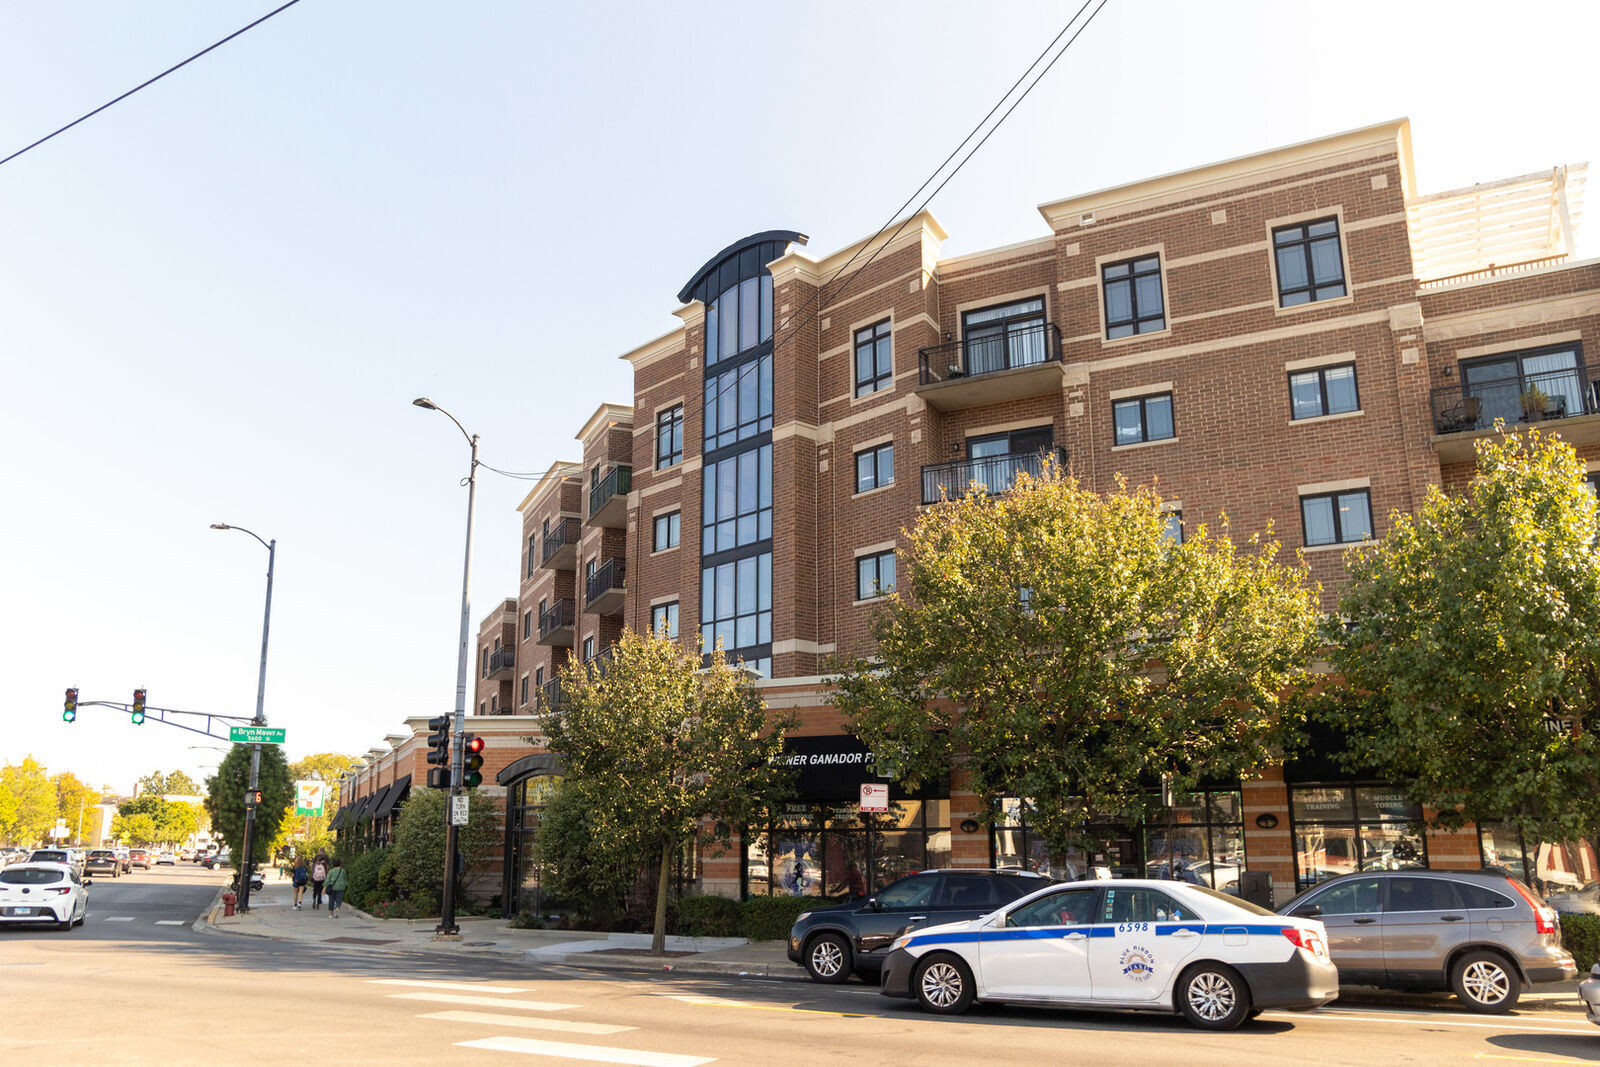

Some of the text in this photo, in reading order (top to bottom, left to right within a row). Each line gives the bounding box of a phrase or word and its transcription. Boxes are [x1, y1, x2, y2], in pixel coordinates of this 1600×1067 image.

[238, 727, 255, 736] Bryn
[256, 728, 276, 736] Mawr
[809, 753, 862, 765] GANADOR
[1119, 922, 1148, 932] 6598
[1120, 945, 1154, 965] BLUE RIBBON
[1128, 963, 1149, 971] TAXI
